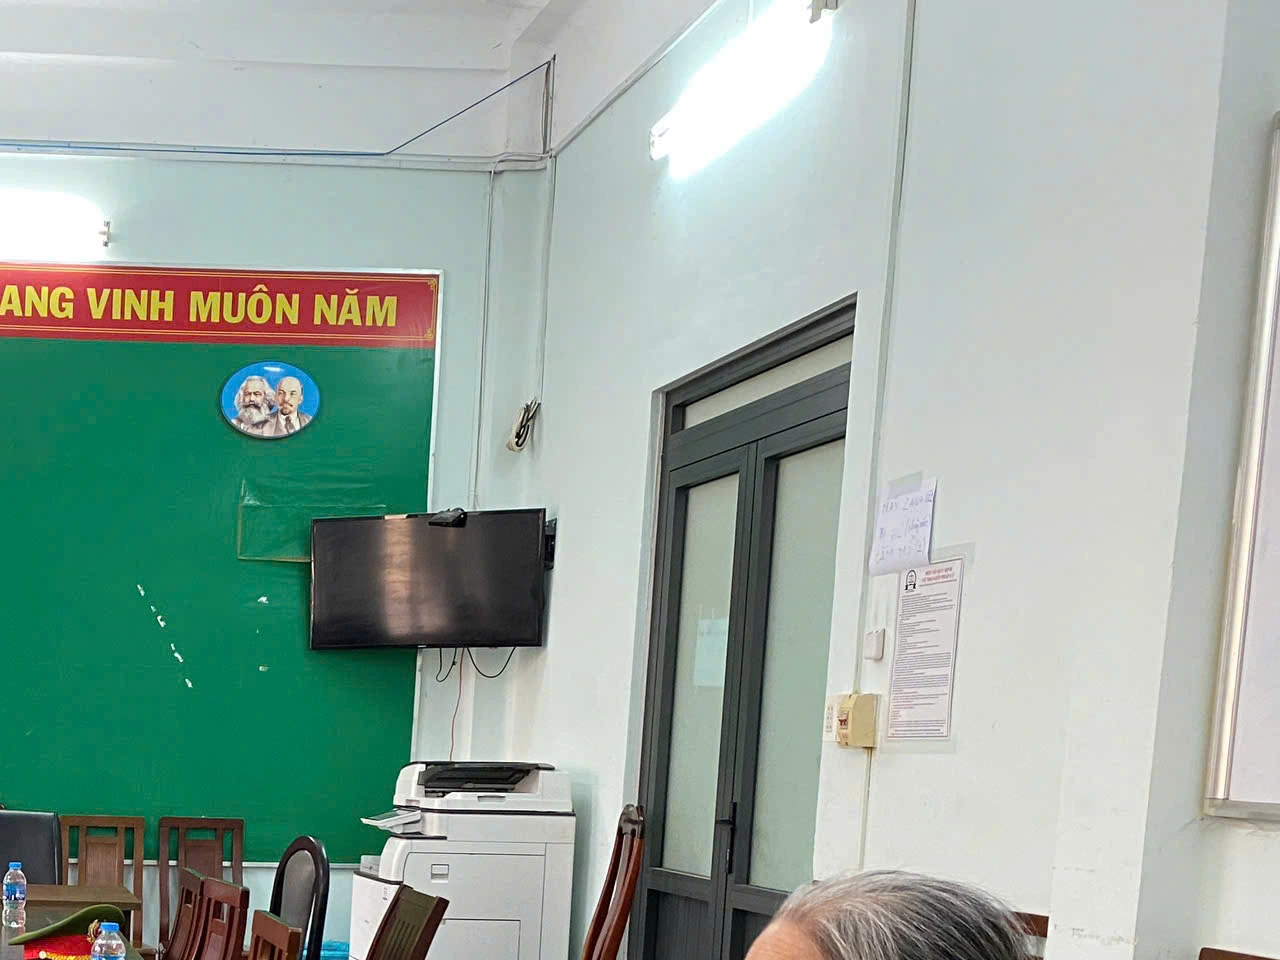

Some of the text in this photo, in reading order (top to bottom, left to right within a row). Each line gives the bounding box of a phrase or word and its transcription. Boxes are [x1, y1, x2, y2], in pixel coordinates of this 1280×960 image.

[87, 288, 174, 322] VINH
[190, 284, 299, 325] MUÔN
[314, 288, 397, 327] NĂM
